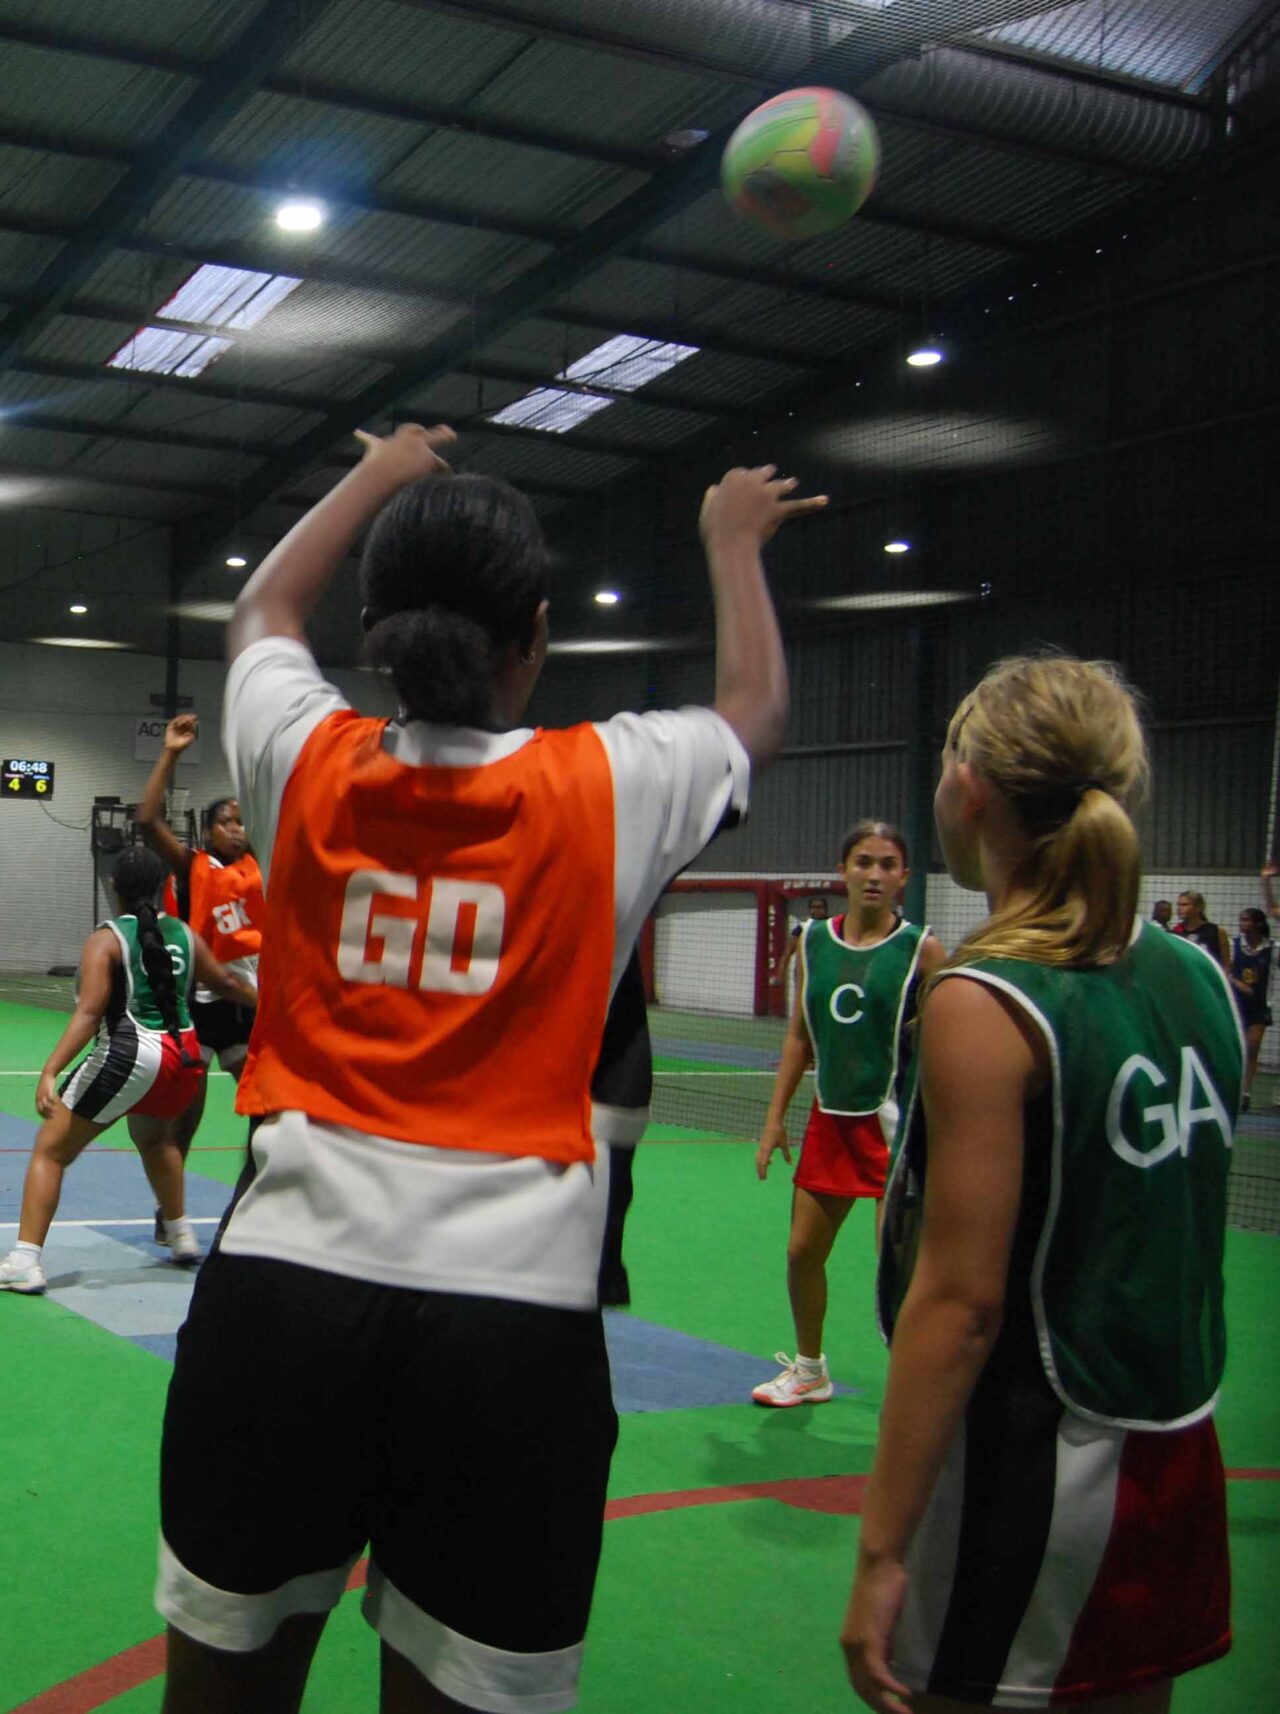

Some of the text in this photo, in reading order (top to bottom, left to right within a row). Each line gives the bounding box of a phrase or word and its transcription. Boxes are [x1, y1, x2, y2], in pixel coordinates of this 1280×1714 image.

[8, 778, 47, 793] 4 6
[9, 760, 48, 773] 06:48
[212, 898, 252, 934] GK
[337, 868, 505, 996] GD
[829, 983, 865, 1024] C
[1106, 1045, 1232, 1168] GA
